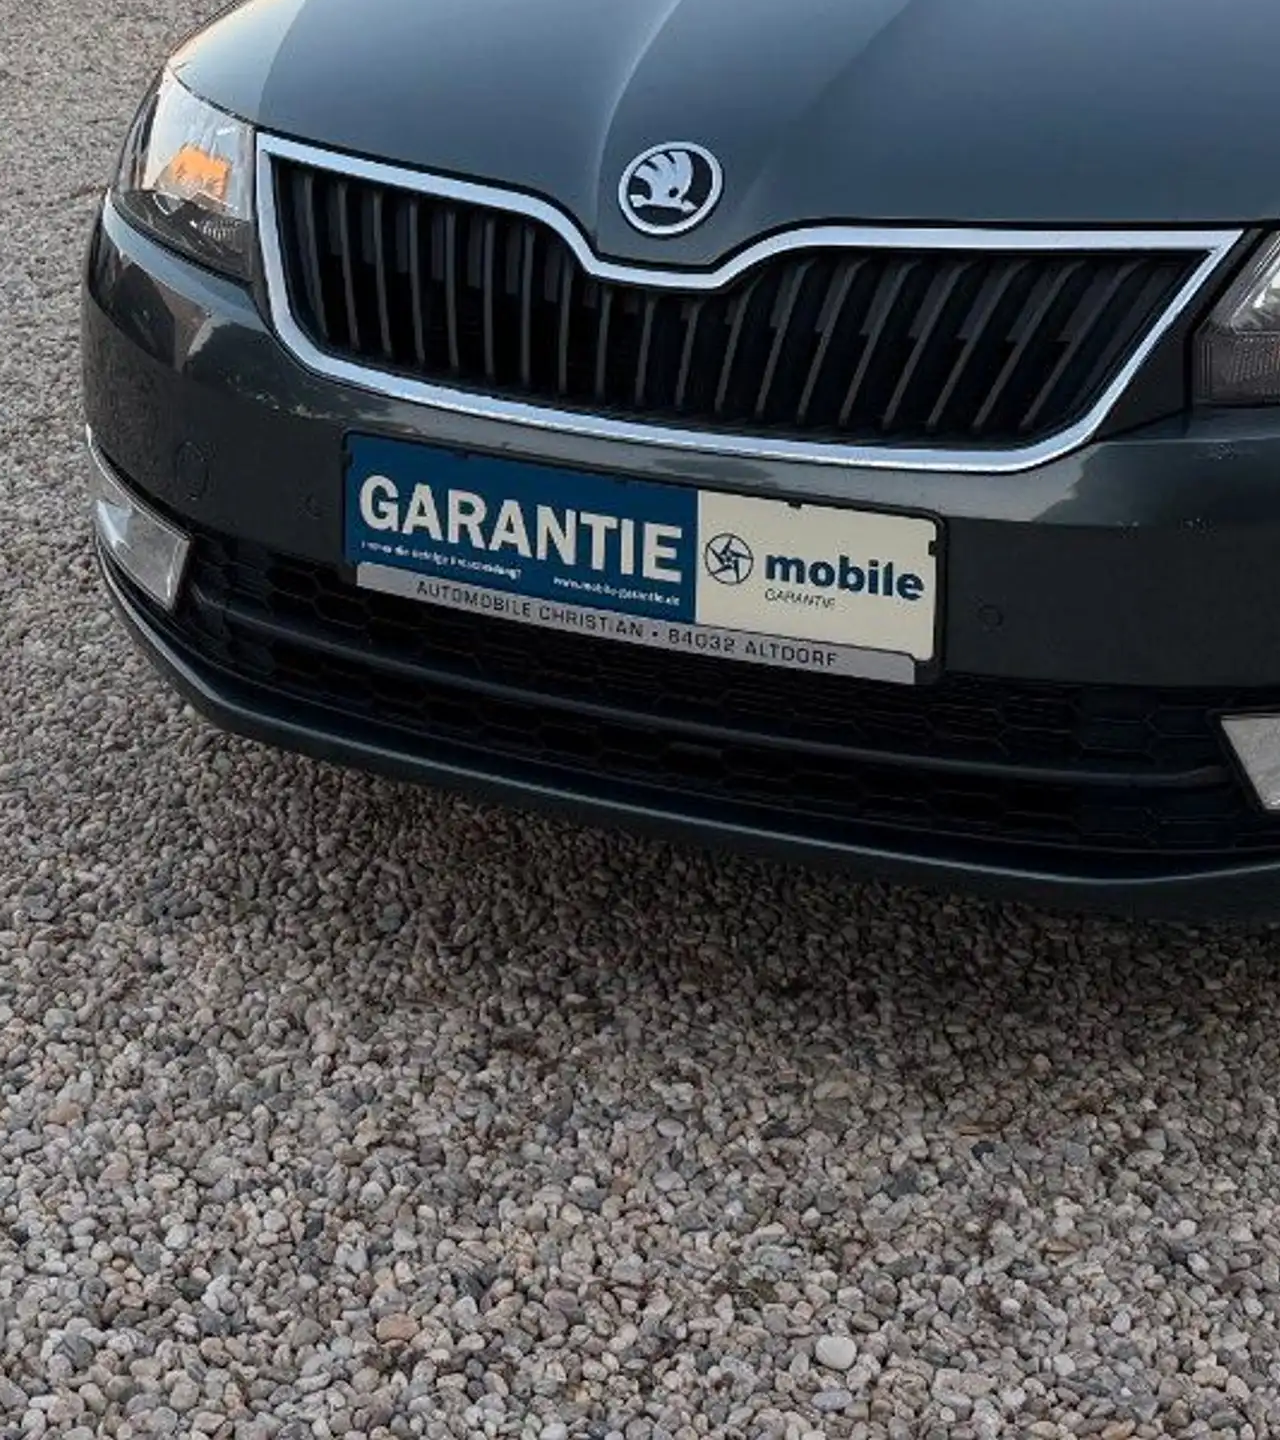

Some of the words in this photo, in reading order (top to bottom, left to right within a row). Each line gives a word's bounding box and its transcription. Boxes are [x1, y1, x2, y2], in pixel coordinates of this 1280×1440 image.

[359, 475, 682, 583] GARANTIE
[765, 554, 924, 601] mobile
[417, 580, 531, 618] AUTOMOBILE
[539, 606, 644, 637] CHRISTIAN
[668, 628, 735, 654] 84032
[745, 640, 837, 666] ALTDORF
